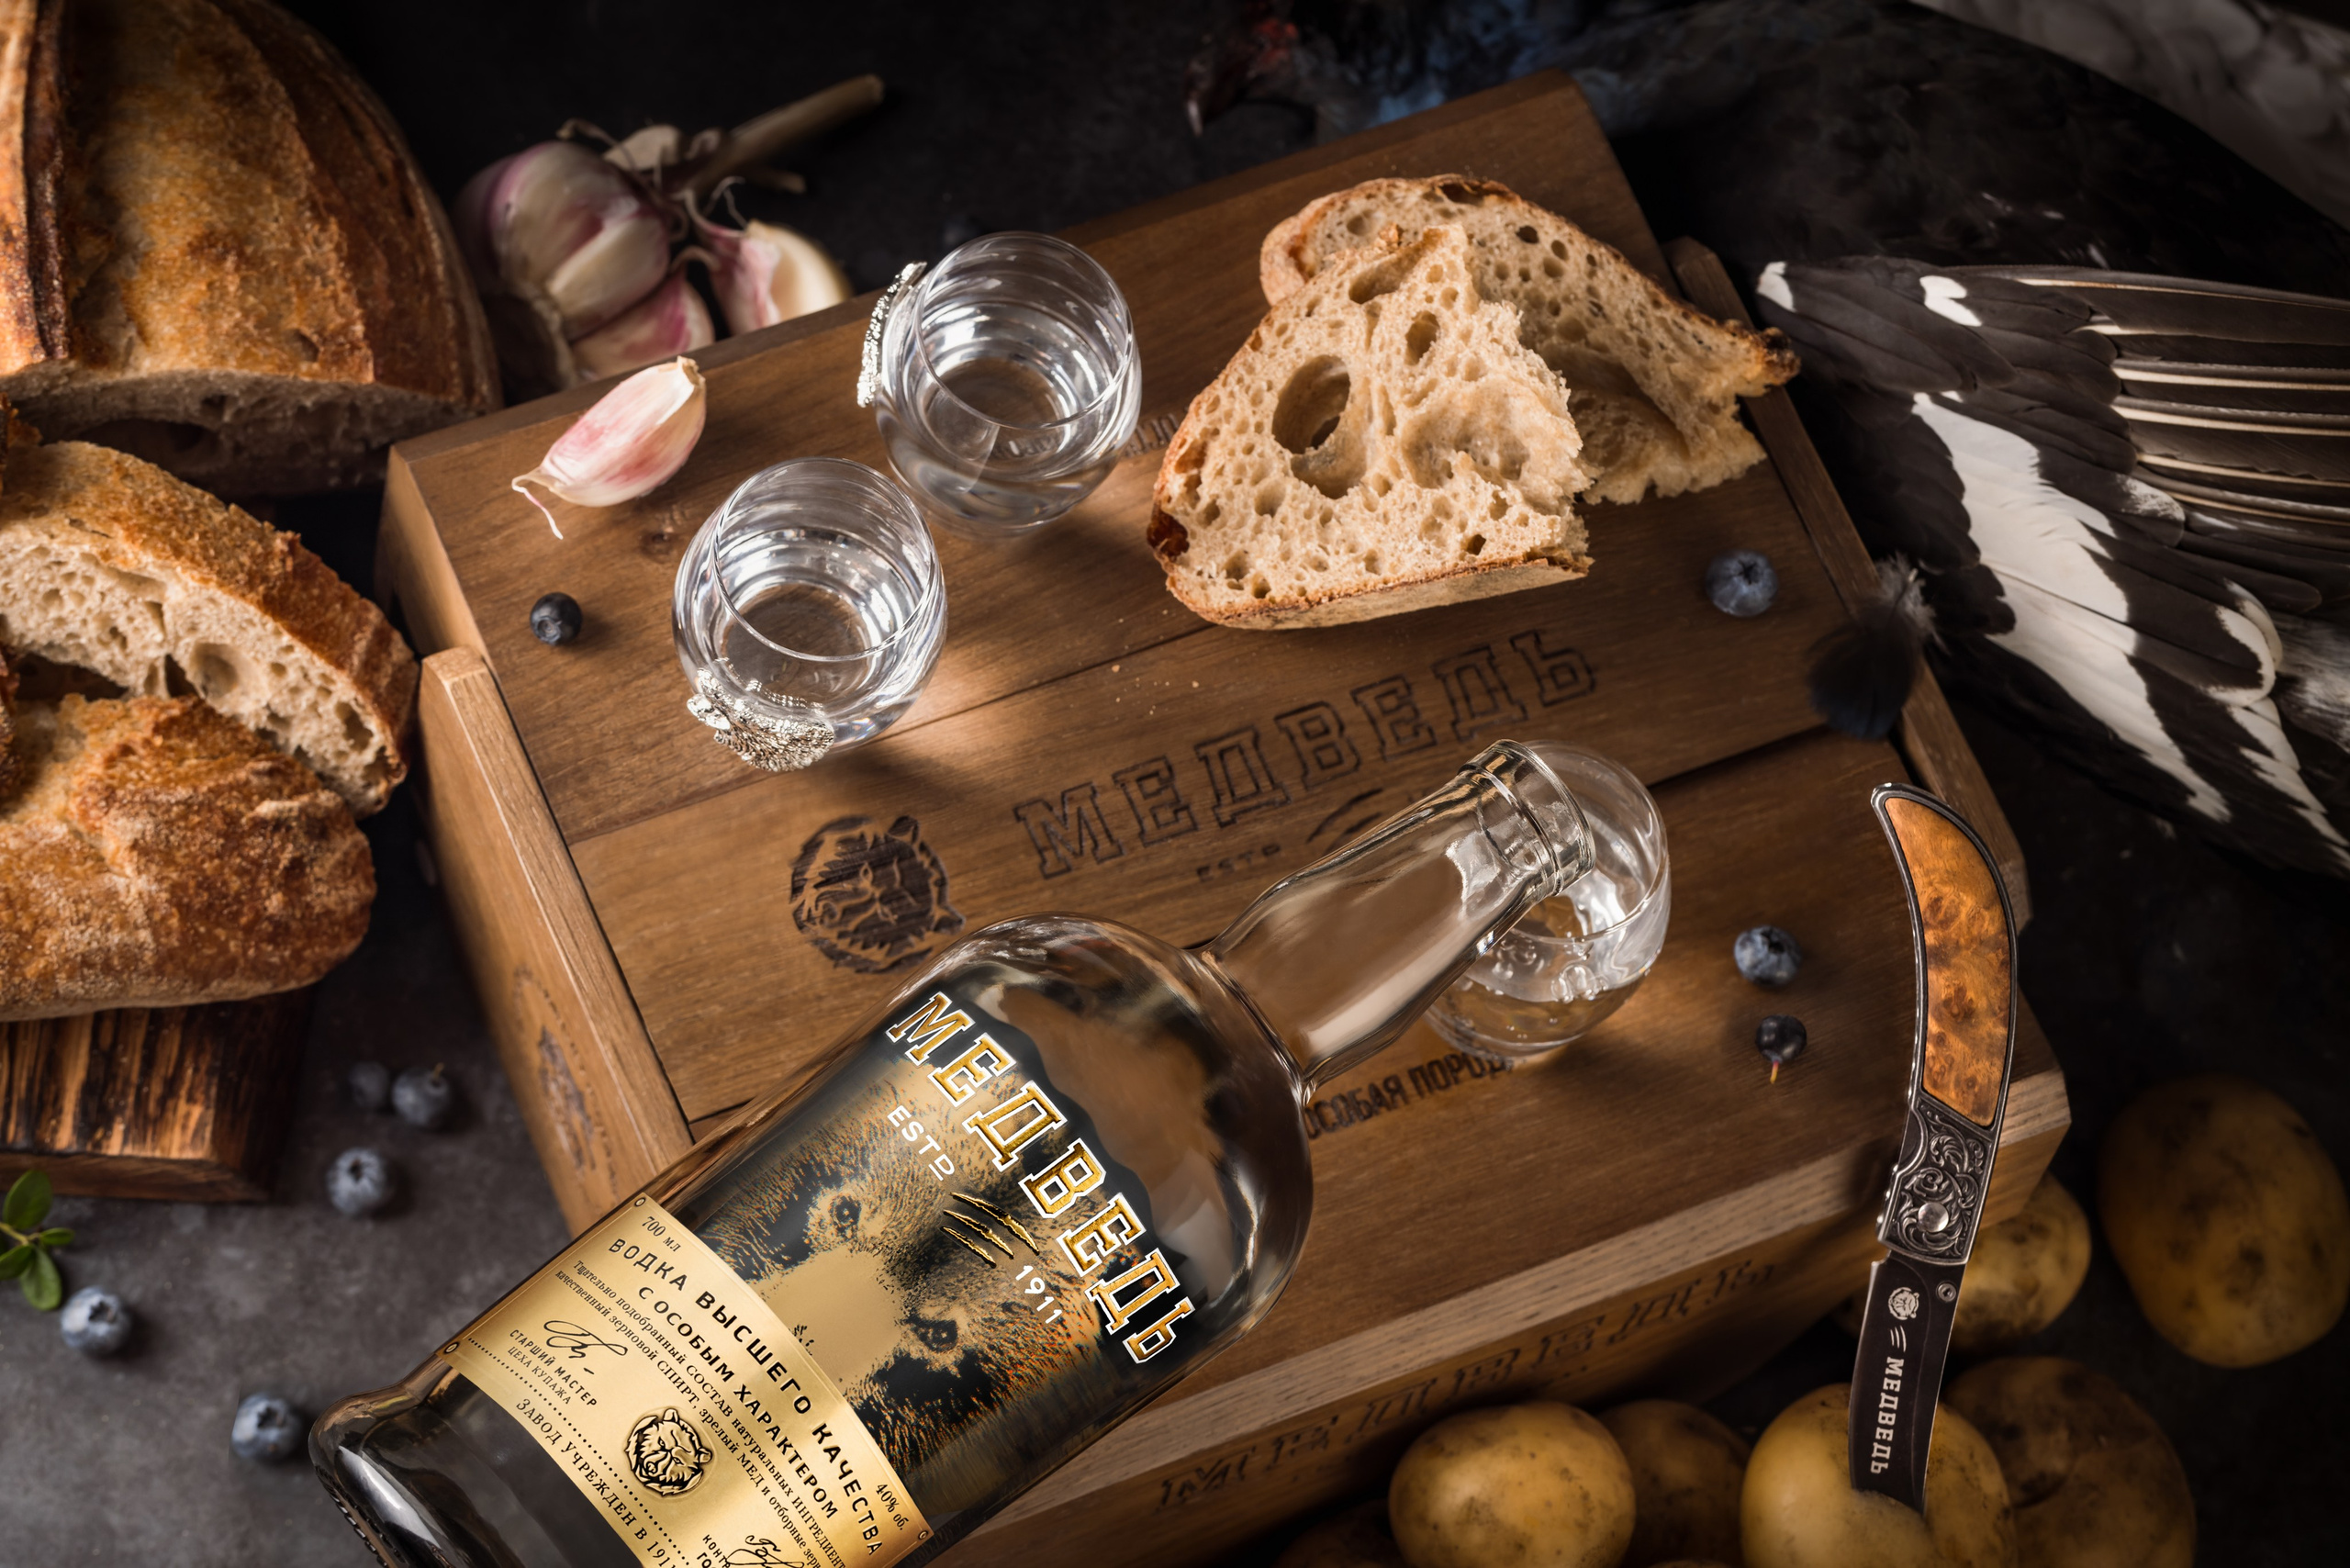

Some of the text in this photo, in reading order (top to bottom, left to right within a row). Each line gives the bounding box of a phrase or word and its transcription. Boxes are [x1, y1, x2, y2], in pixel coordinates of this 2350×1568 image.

[1013, 628, 1598, 879] МЕДВЕДЬ
[886, 991, 1196, 1364] МЕДВЕДЬ
[1304, 1074, 1410, 1140] ОСОБАЯ
[642, 1215, 681, 1252] 700 мл
[1014, 1264, 1064, 1325] 1911
[508, 1346, 532, 1368] ЦЕХА
[532, 1365, 572, 1405] КУПАЖА
[509, 1329, 556, 1367] СТАРШИЙ
[554, 1366, 598, 1406] МАСТЕР
[554, 1270, 613, 1317] качественный
[609, 1315, 658, 1361] зерновой
[657, 1360, 700, 1409] СПИРТ,
[699, 1408, 738, 1454] зрелый
[736, 1452, 765, 1488] МЕД
[761, 1485, 771, 1496] и
[768, 1496, 807, 1550] отборные
[573, 1260, 618, 1299] Тщательно
[616, 1297, 687, 1364] подобранный
[686, 1364, 733, 1417] СОСТАВ
[731, 1418, 794, 1497] натуральных
[608, 1238, 883, 1556] ВОДКА ВЫСШЕГО КАЧЕСТВА
[638, 1286, 655, 1300] С
[654, 1300, 734, 1382] ОСОБЫМ
[733, 1383, 839, 1518] ХАРАКТЕРОМ
[1870, 1356, 1905, 1474] МЕДВЕДЬ
[516, 1398, 676, 1568] ЗАВОД УЧРЕЖДЕН В 191
[876, 1484, 910, 1530] 40% об.
